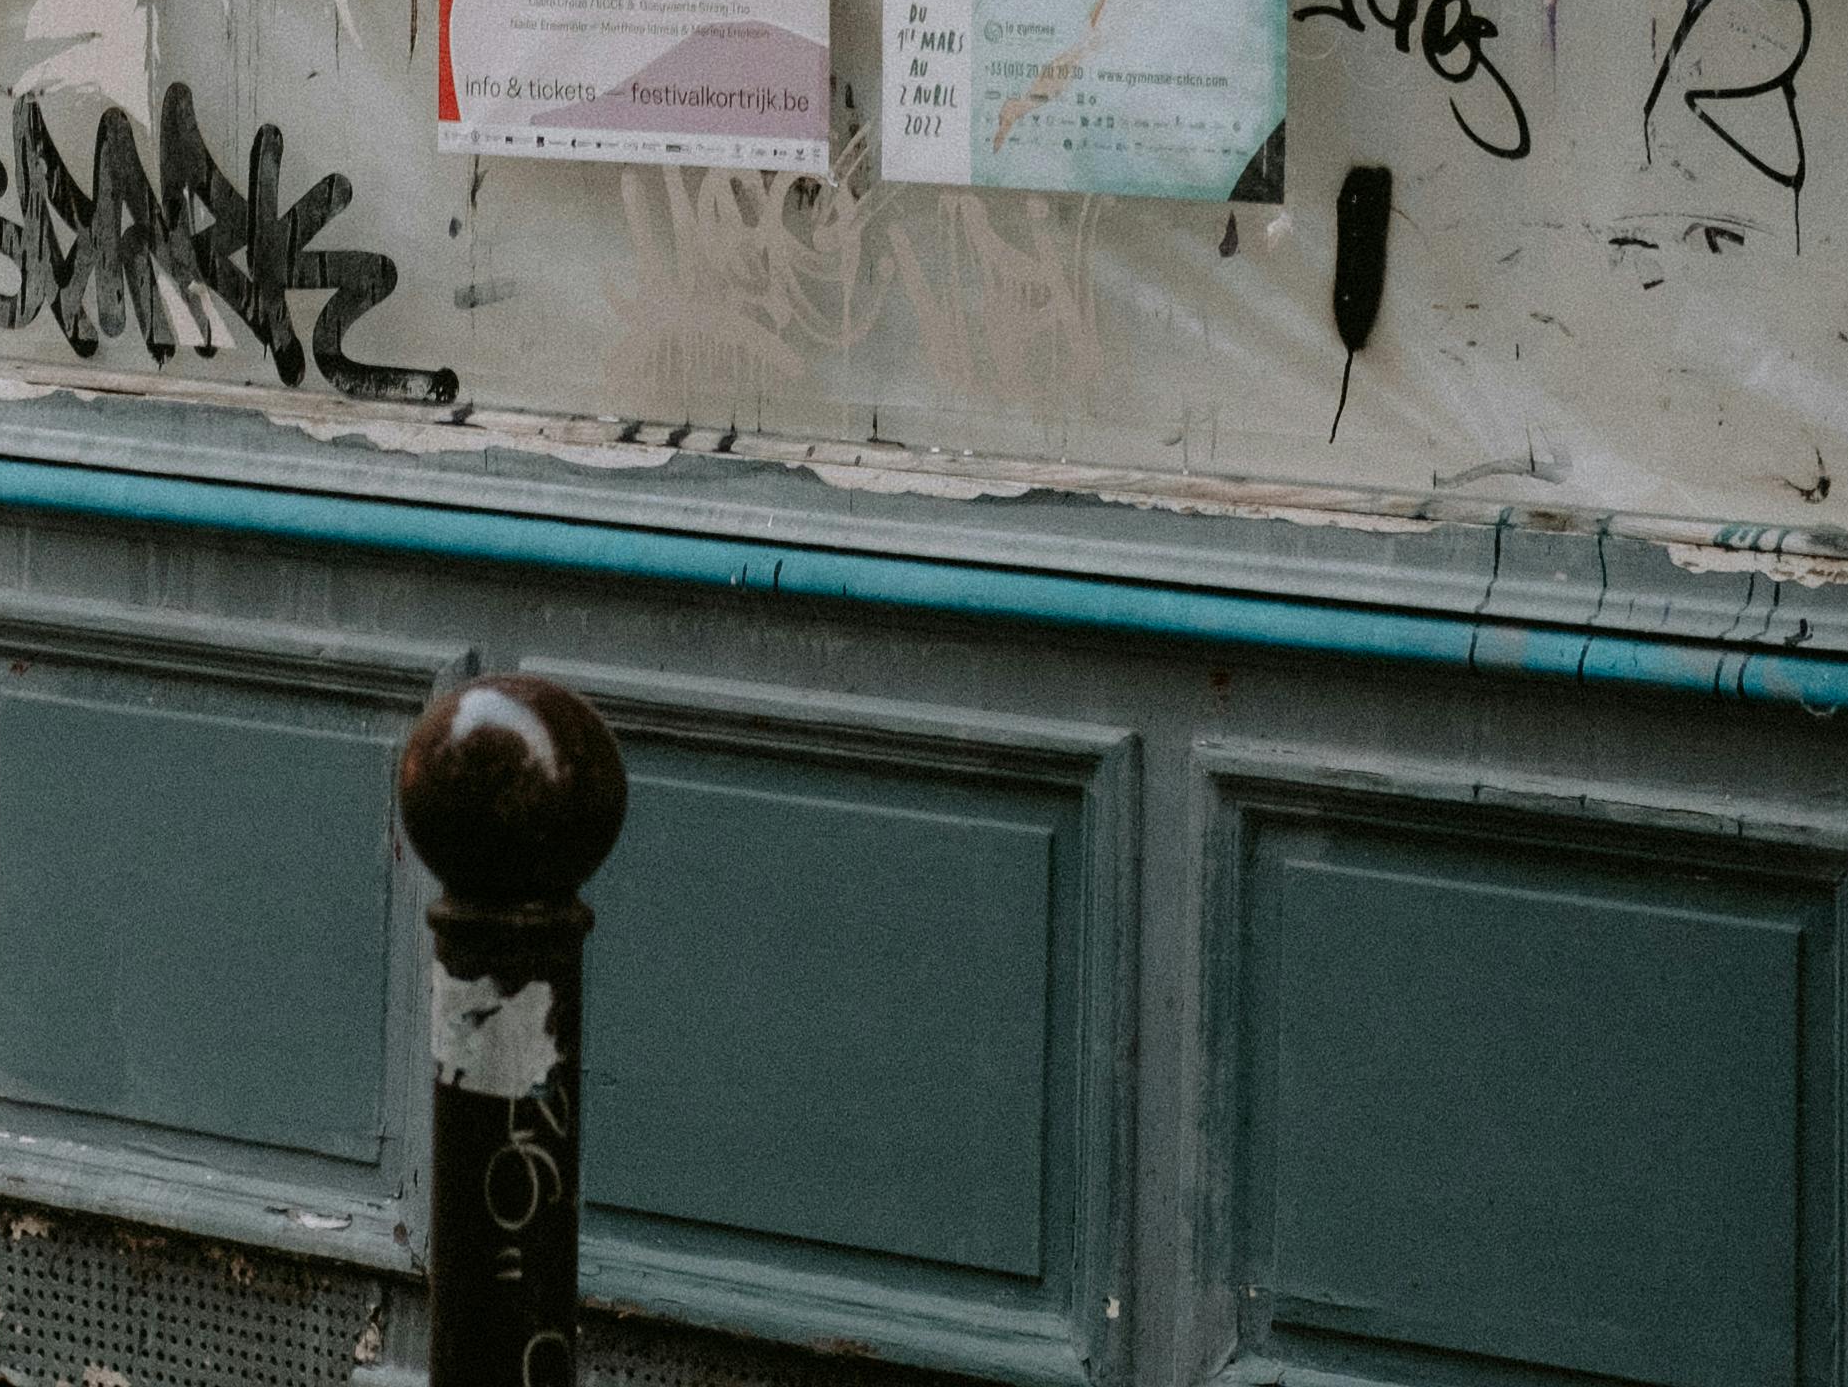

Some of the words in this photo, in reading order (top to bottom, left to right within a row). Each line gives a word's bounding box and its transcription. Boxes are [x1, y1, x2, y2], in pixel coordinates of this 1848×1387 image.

[909, 3, 927, 23] DU
[921, 31, 964, 54] MARS
[909, 57, 928, 77] AU
[465, 76, 501, 99] info
[506, 78, 523, 99] &
[529, 79, 596, 102] tickets
[631, 82, 809, 115] festivalkortrijk.be
[913, 84, 957, 108] AVRIL
[904, 114, 942, 137] 2022
